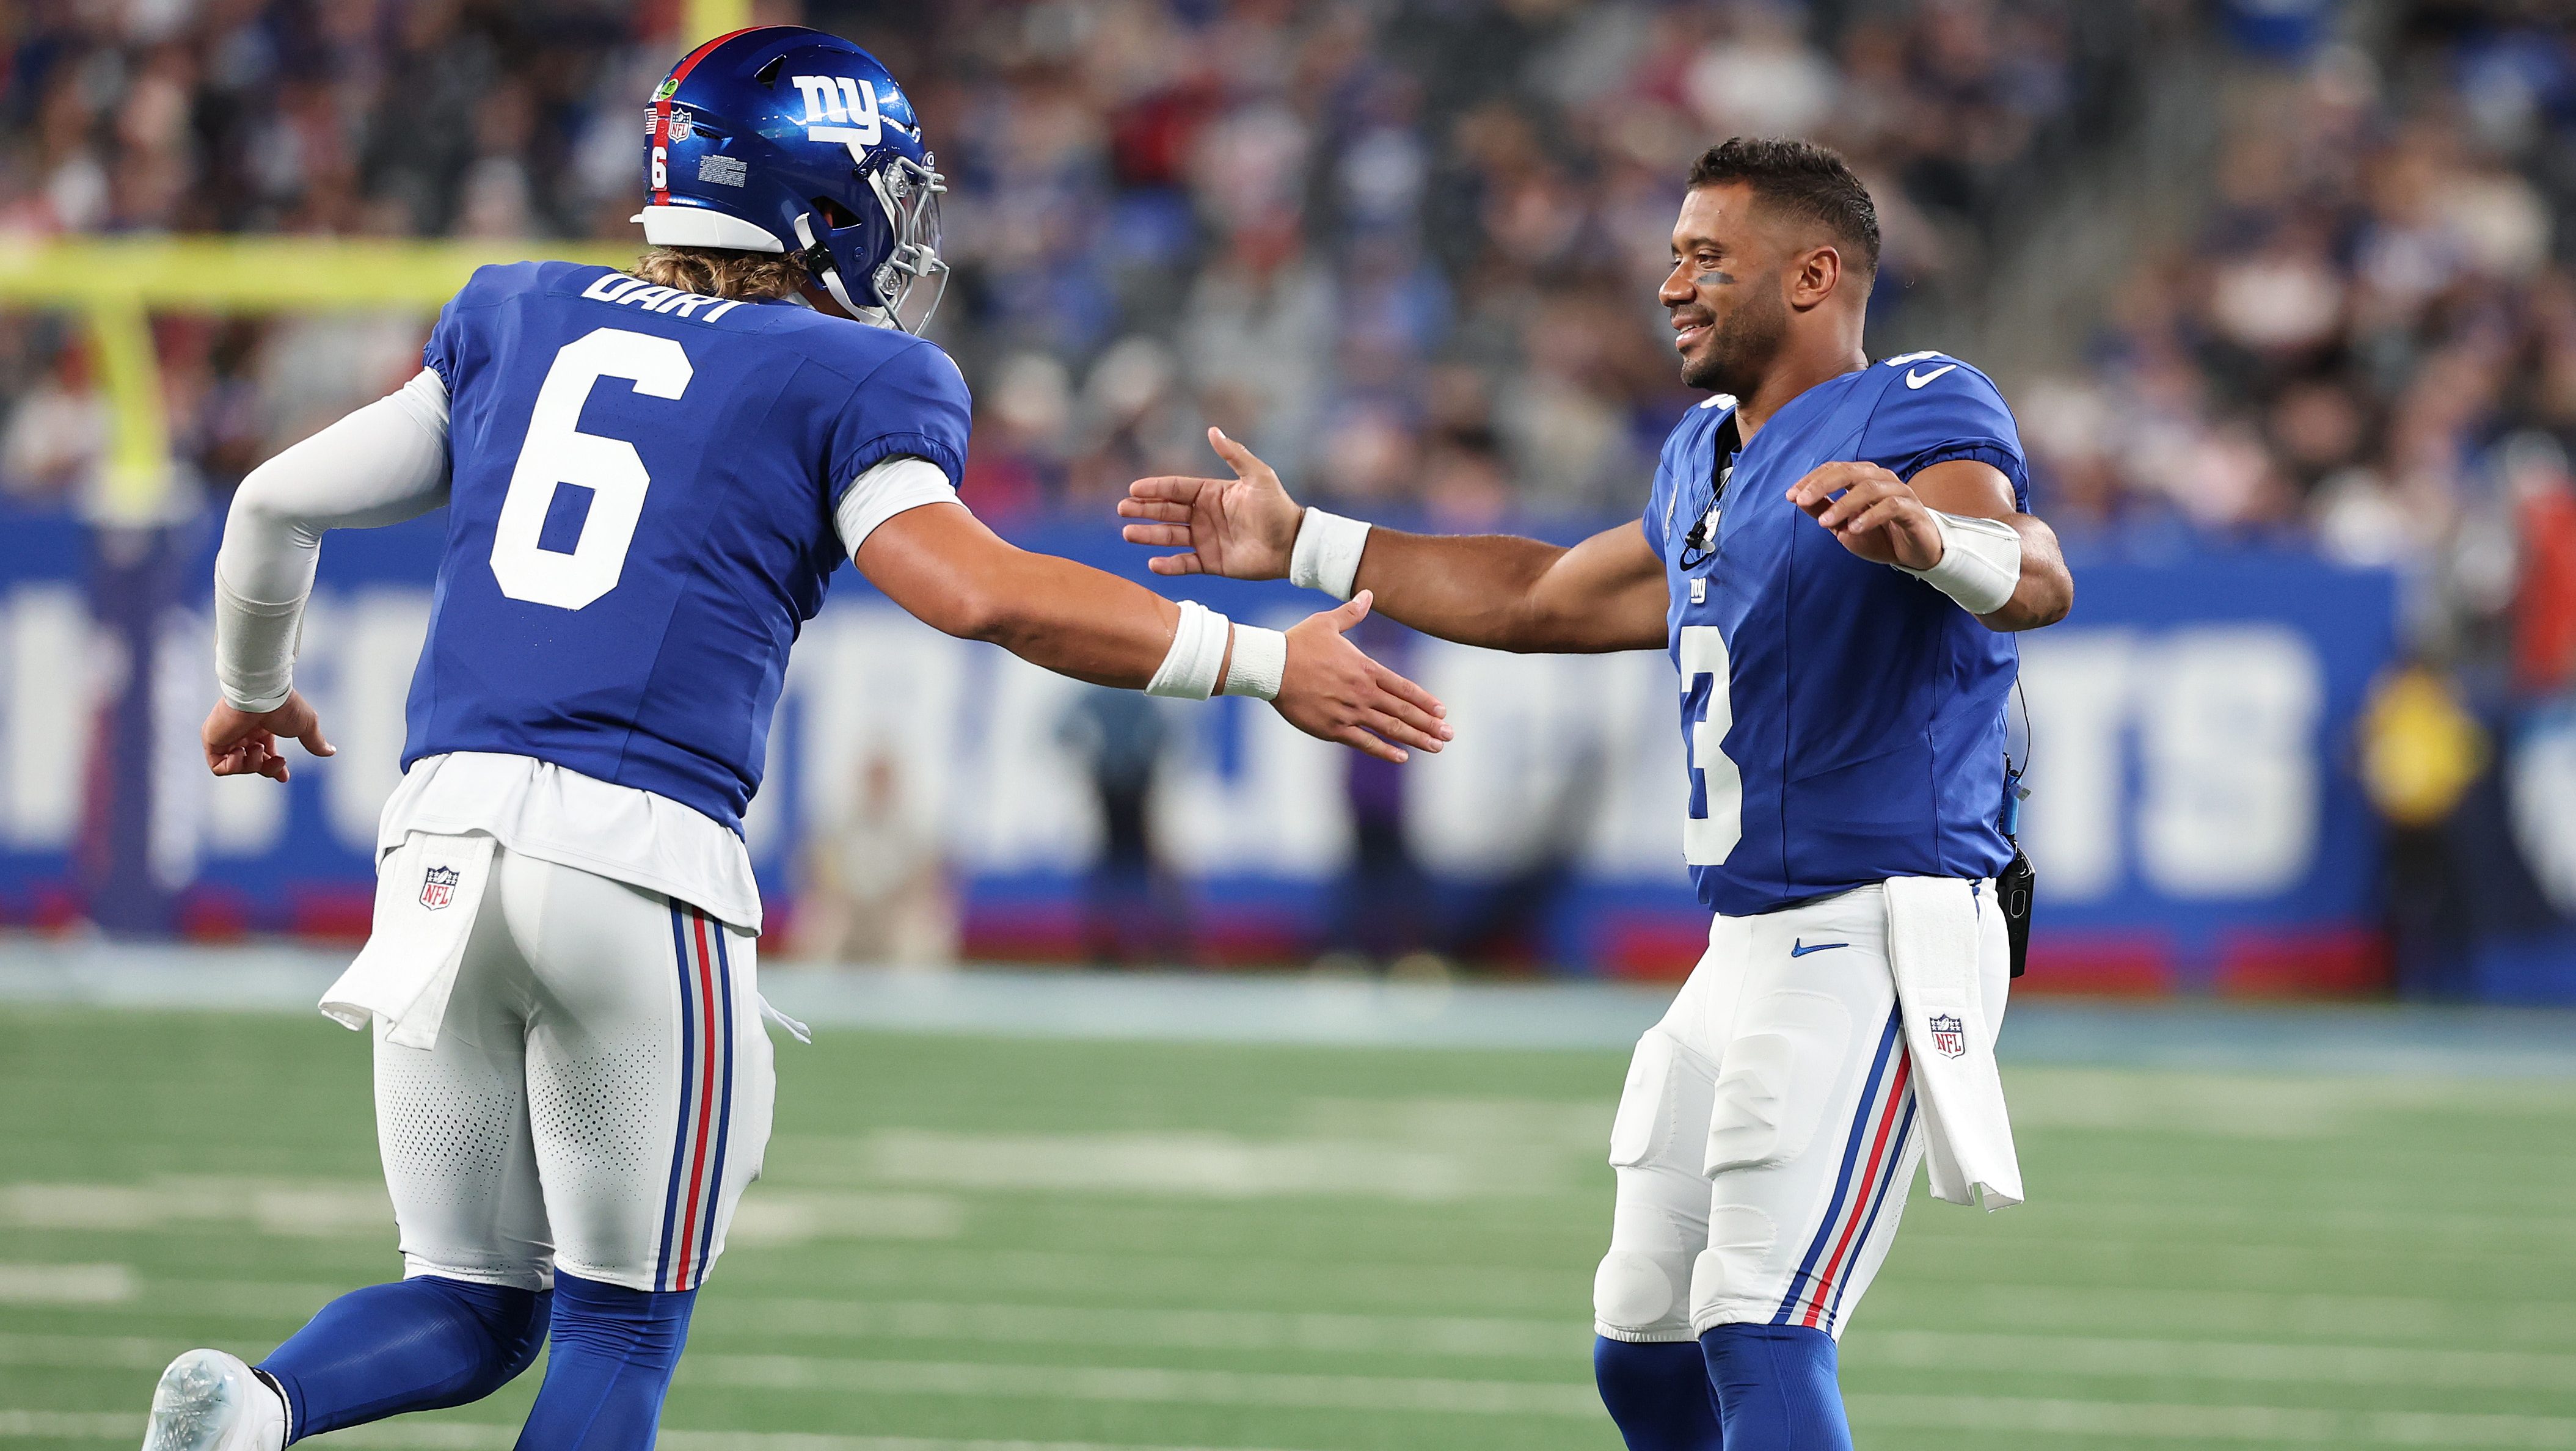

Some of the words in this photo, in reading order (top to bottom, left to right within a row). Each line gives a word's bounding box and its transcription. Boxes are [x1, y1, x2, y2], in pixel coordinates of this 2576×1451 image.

[672, 123, 687, 137] NFL
[652, 147, 667, 188] 6
[581, 273, 750, 323] DART
[489, 327, 694, 611] 6
[1680, 625, 1742, 866] 3
[423, 884, 450, 906] NFL
[1935, 1033, 1961, 1054] NFL
